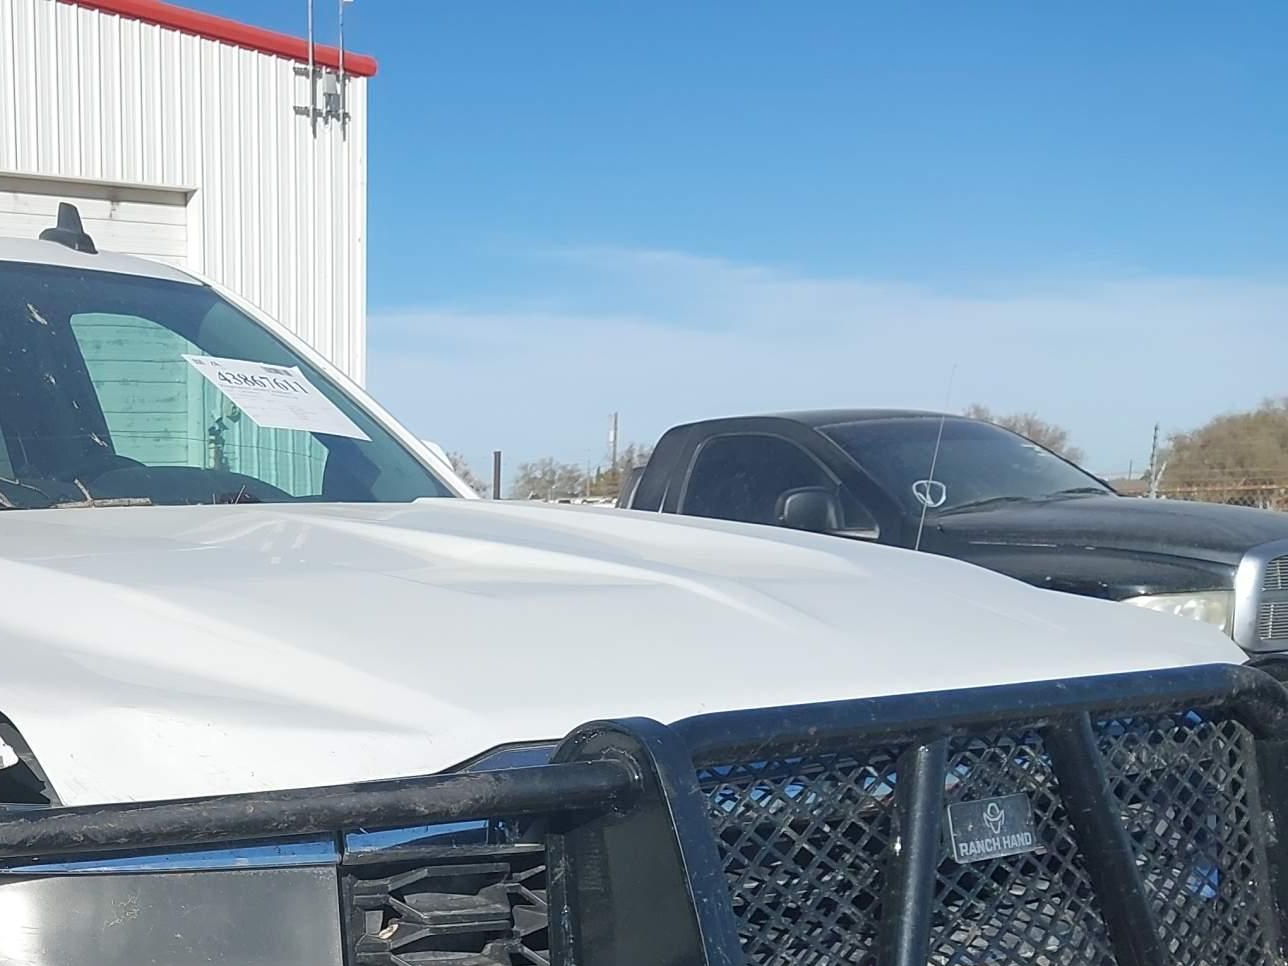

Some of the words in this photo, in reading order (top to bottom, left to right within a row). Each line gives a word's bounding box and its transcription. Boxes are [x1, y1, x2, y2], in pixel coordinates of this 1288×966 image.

[217, 370, 309, 394] 43867611
[958, 837, 1001, 857] RANCH
[1003, 832, 1032, 849] HAND
